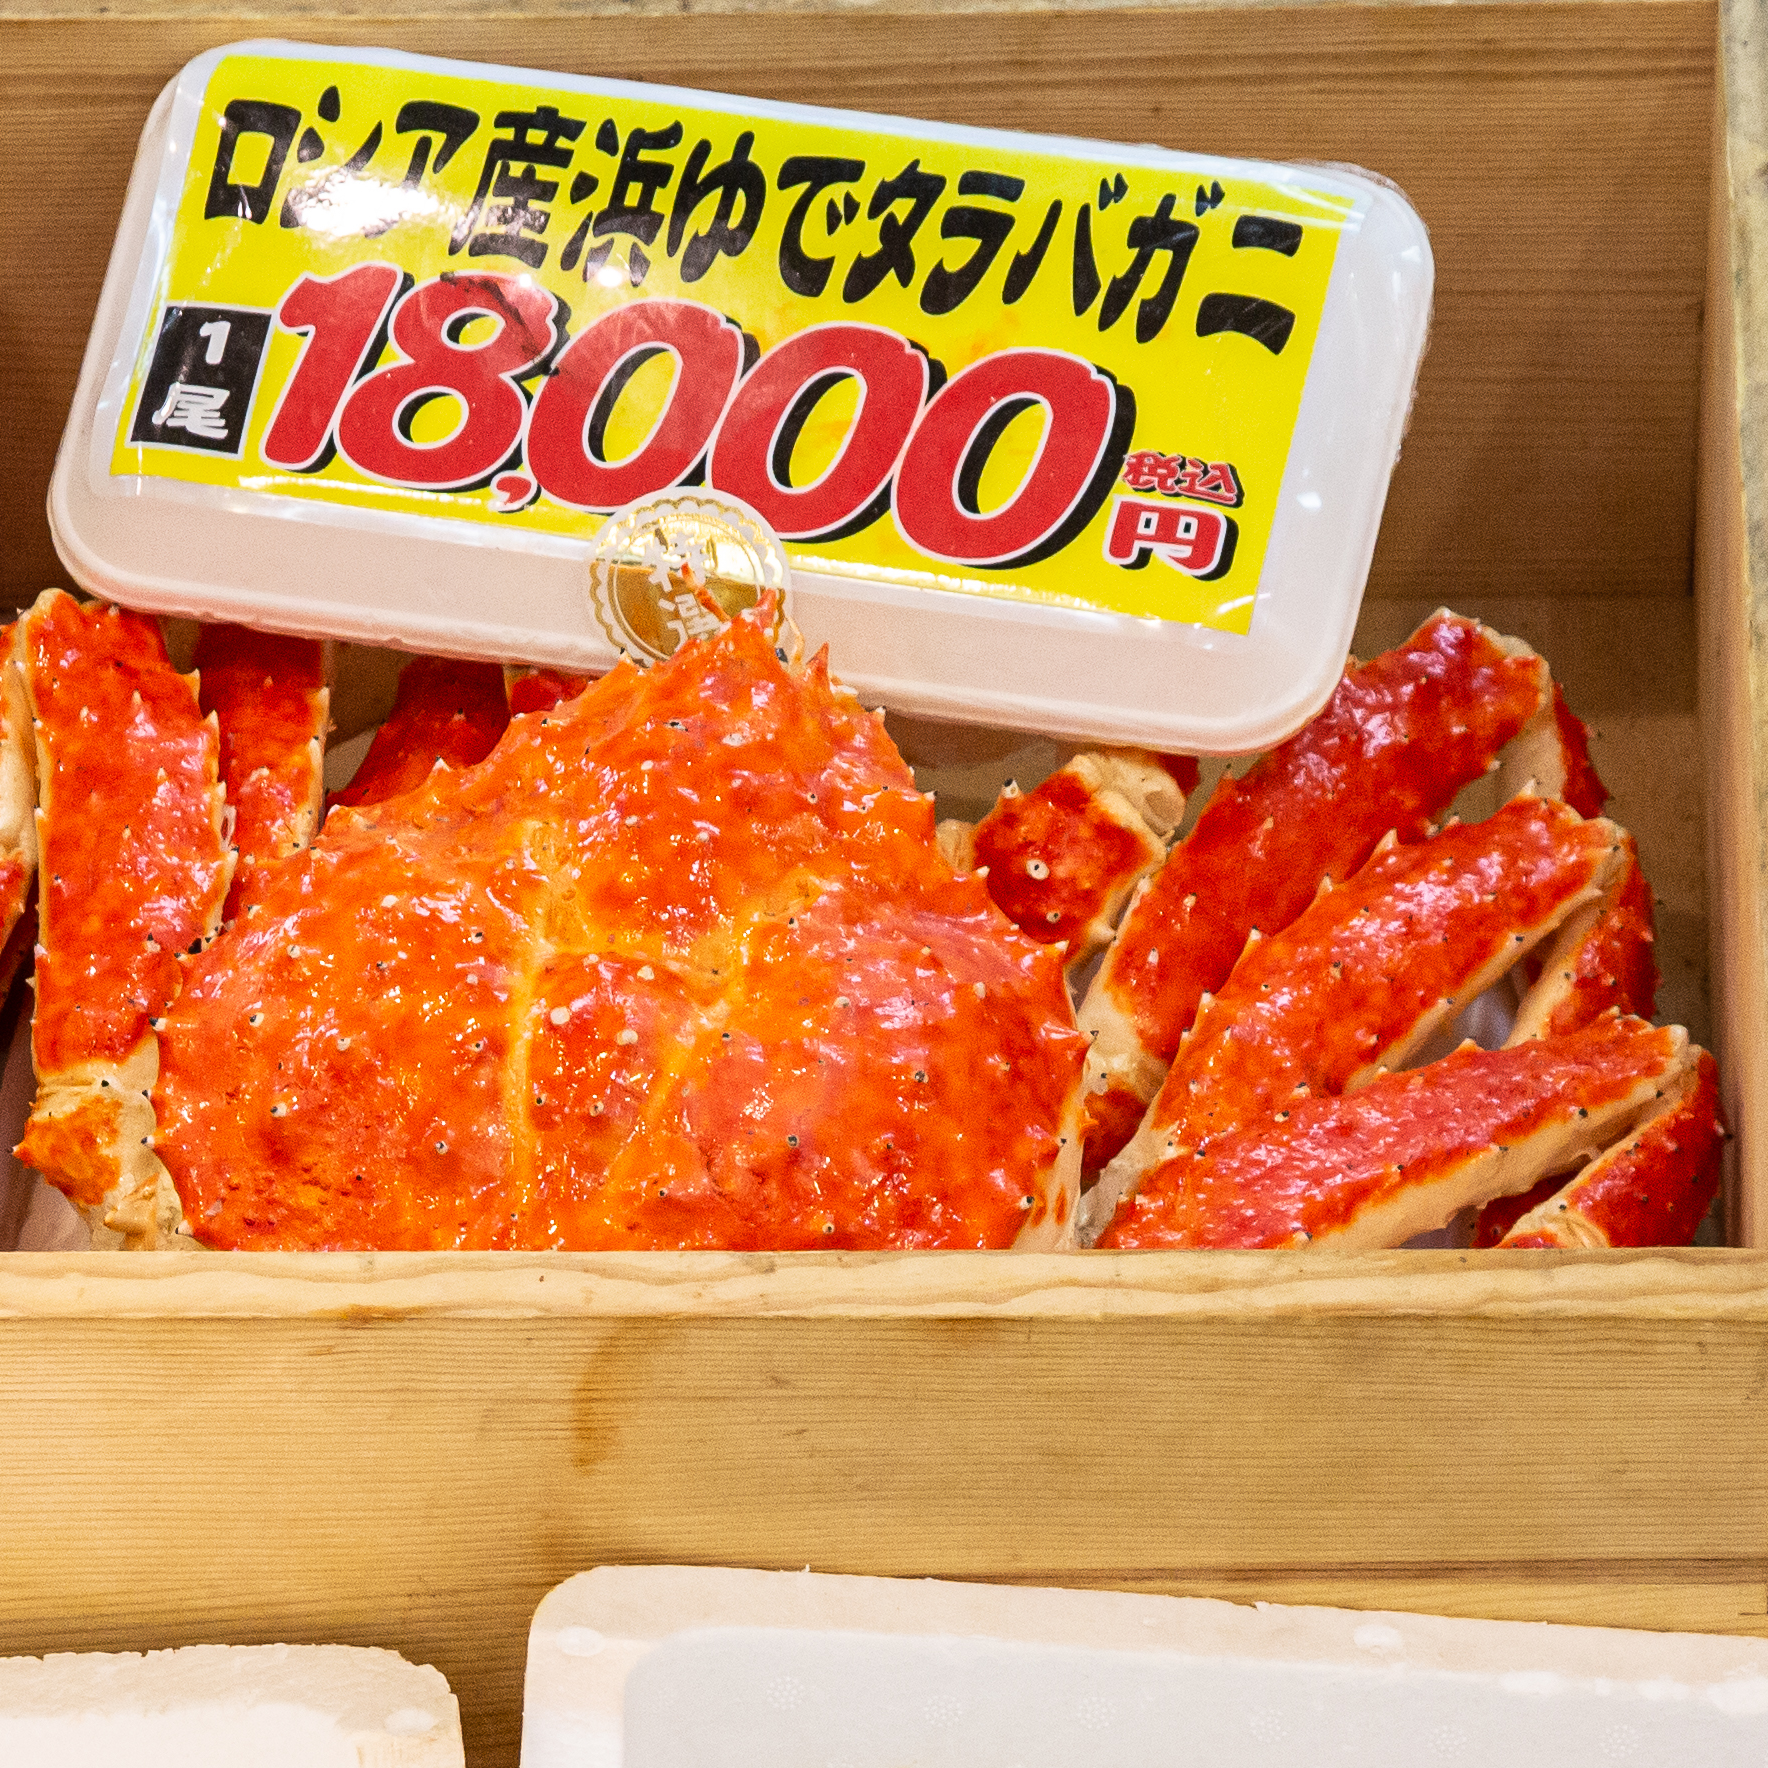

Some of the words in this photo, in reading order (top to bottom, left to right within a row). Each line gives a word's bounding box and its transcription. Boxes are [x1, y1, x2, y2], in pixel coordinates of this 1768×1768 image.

[204, 85, 1305, 356] ロシア産浜ゆでタラバガニ
[152, 320, 231, 441] 1尾
[261, 261, 1139, 568] 18,000
[1103, 495, 1241, 582] 円
[1119, 447, 1246, 508] 税込
